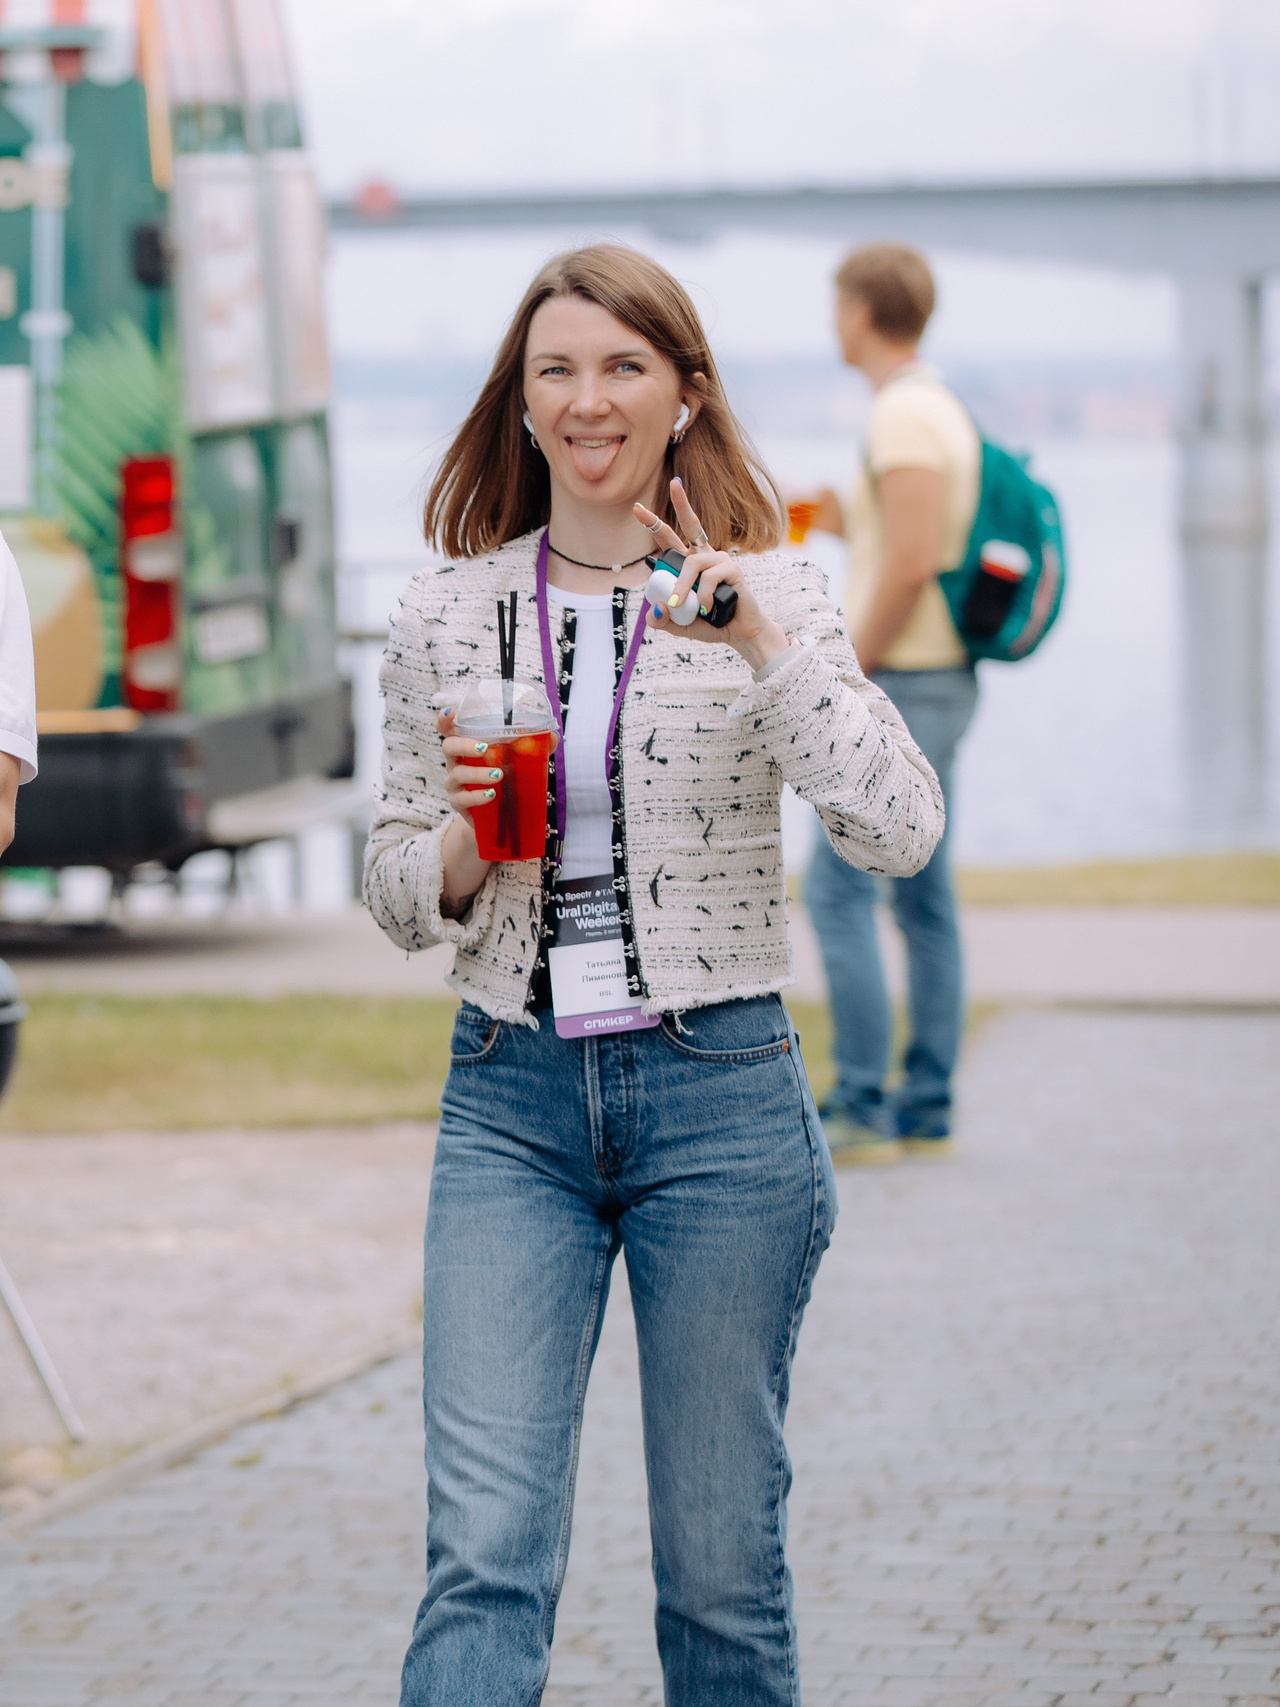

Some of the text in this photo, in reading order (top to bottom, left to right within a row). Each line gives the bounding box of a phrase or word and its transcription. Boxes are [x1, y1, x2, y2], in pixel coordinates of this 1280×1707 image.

[565, 891, 591, 902] Spectr
[556, 901, 619, 919] Ural Digita
[585, 959, 621, 969] Татьяна
[583, 1014, 633, 1030] СПИКЕР
